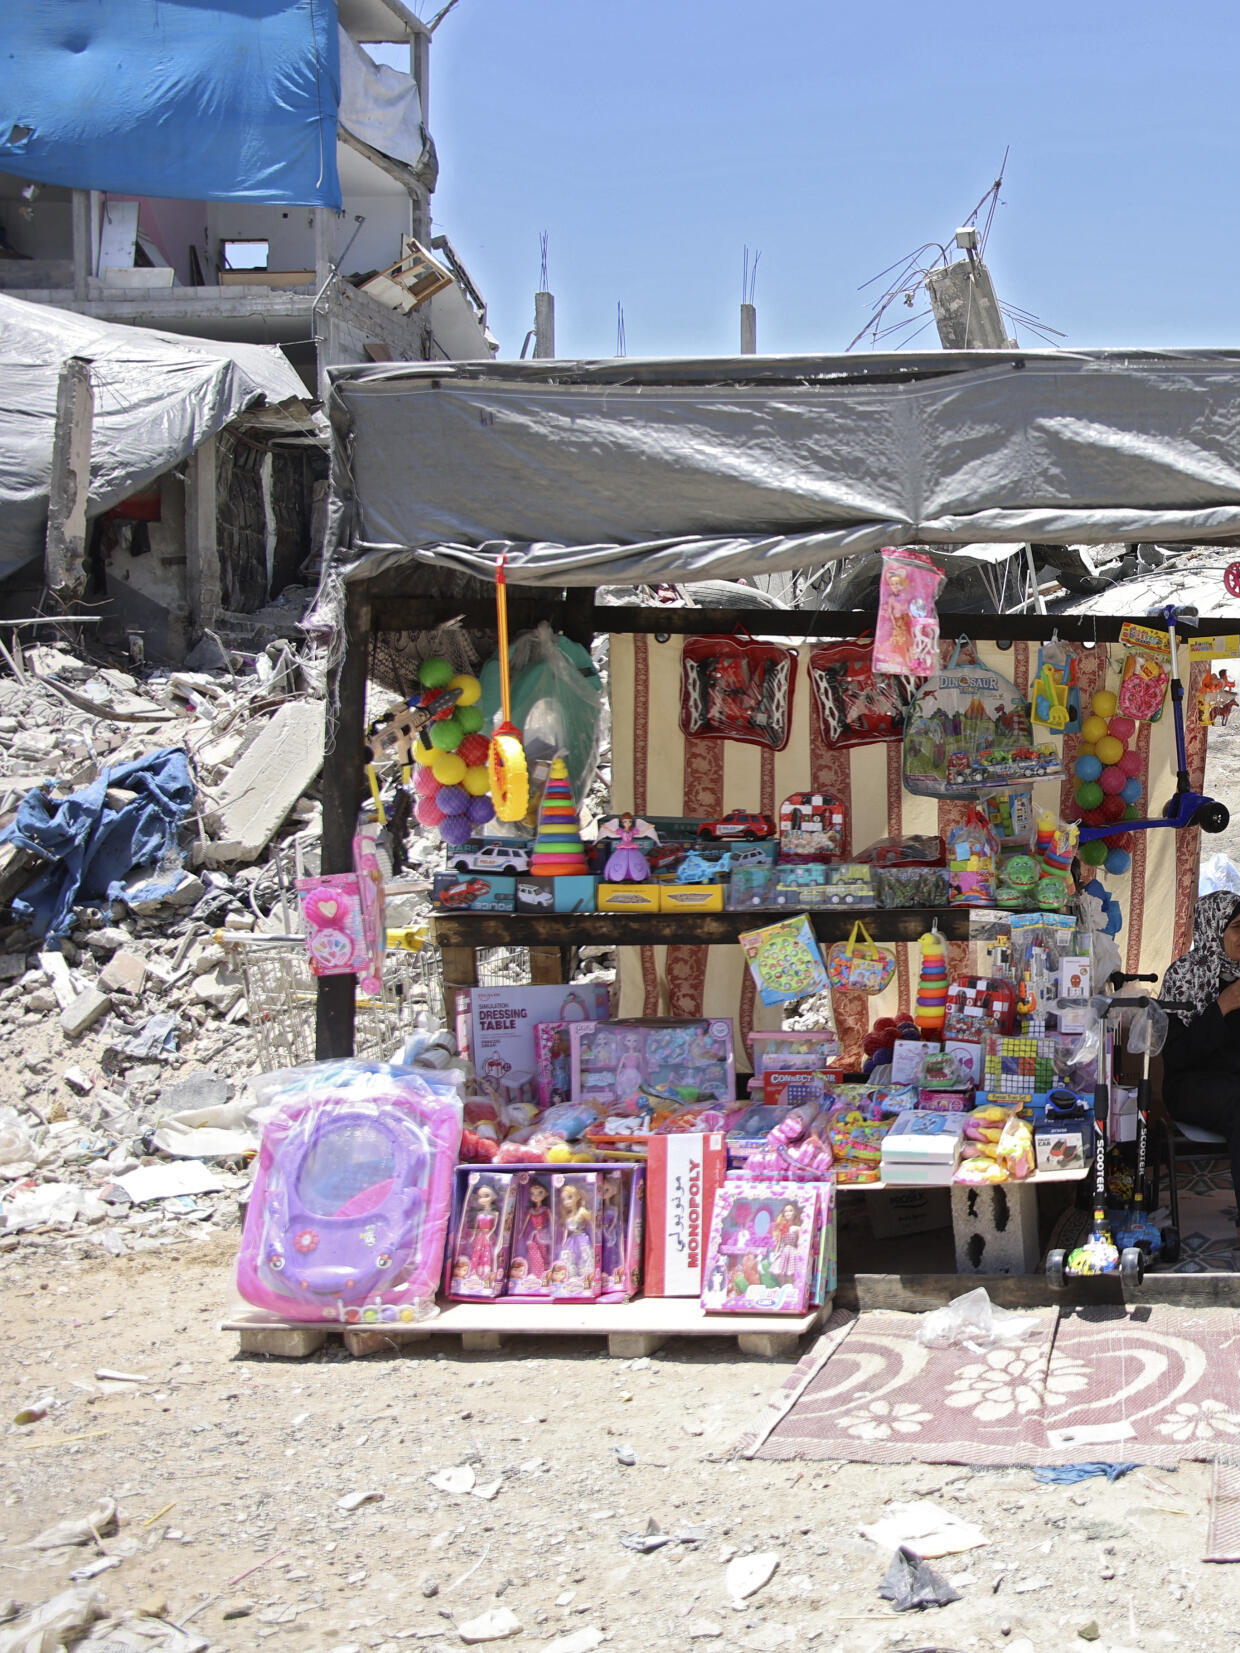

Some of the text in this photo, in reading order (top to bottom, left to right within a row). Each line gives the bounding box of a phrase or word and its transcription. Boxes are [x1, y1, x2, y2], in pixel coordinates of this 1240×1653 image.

[939, 676, 999, 691] DINOSAUR
[479, 1008, 528, 1021] DRESSING
[480, 1020, 517, 1031] TABLE
[1096, 1139, 1105, 1193] SCOOTER
[1138, 1127, 1147, 1175] SCOOTER
[687, 1159, 702, 1269] MONOPOLY
